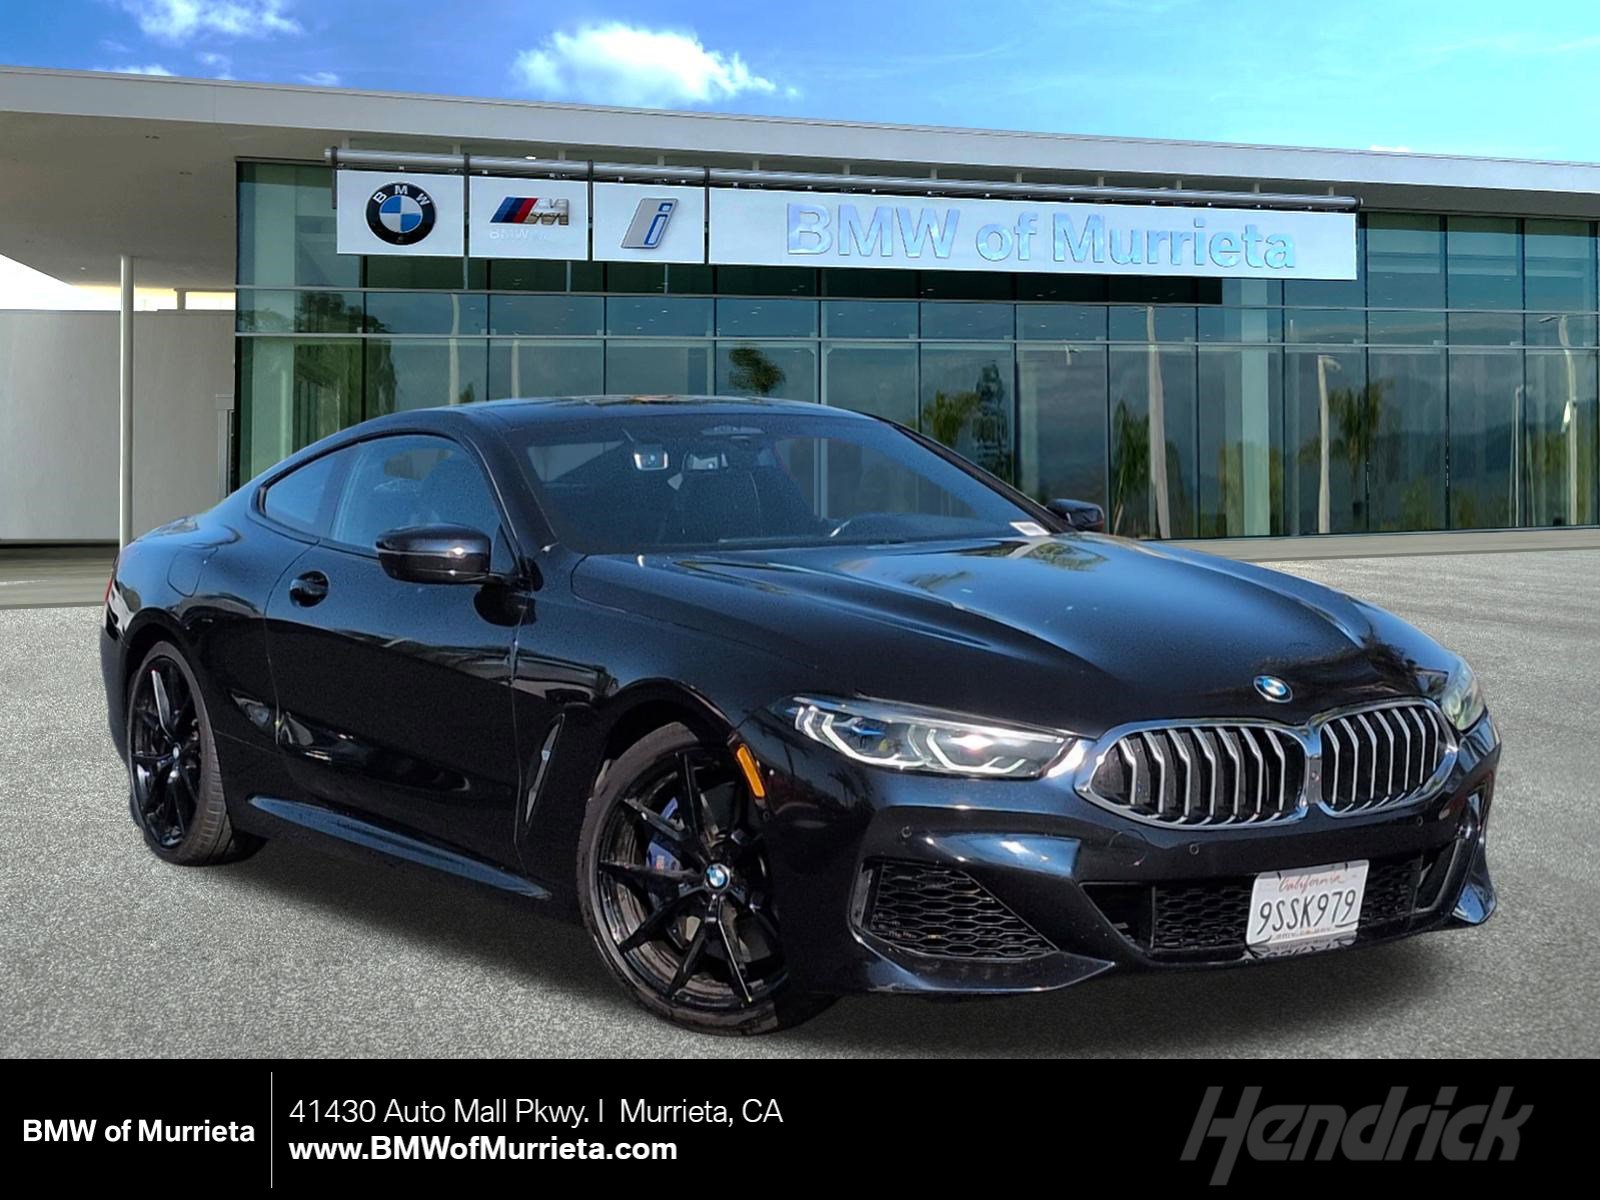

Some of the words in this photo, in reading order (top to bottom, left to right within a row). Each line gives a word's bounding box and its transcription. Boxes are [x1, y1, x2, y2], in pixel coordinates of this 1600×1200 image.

[372, 184, 431, 206] BMW
[787, 201, 960, 259] BMW
[975, 212, 1038, 262] of
[1052, 212, 1297, 269] Murrieta
[1256, 889, 1357, 936] 9SSK979
